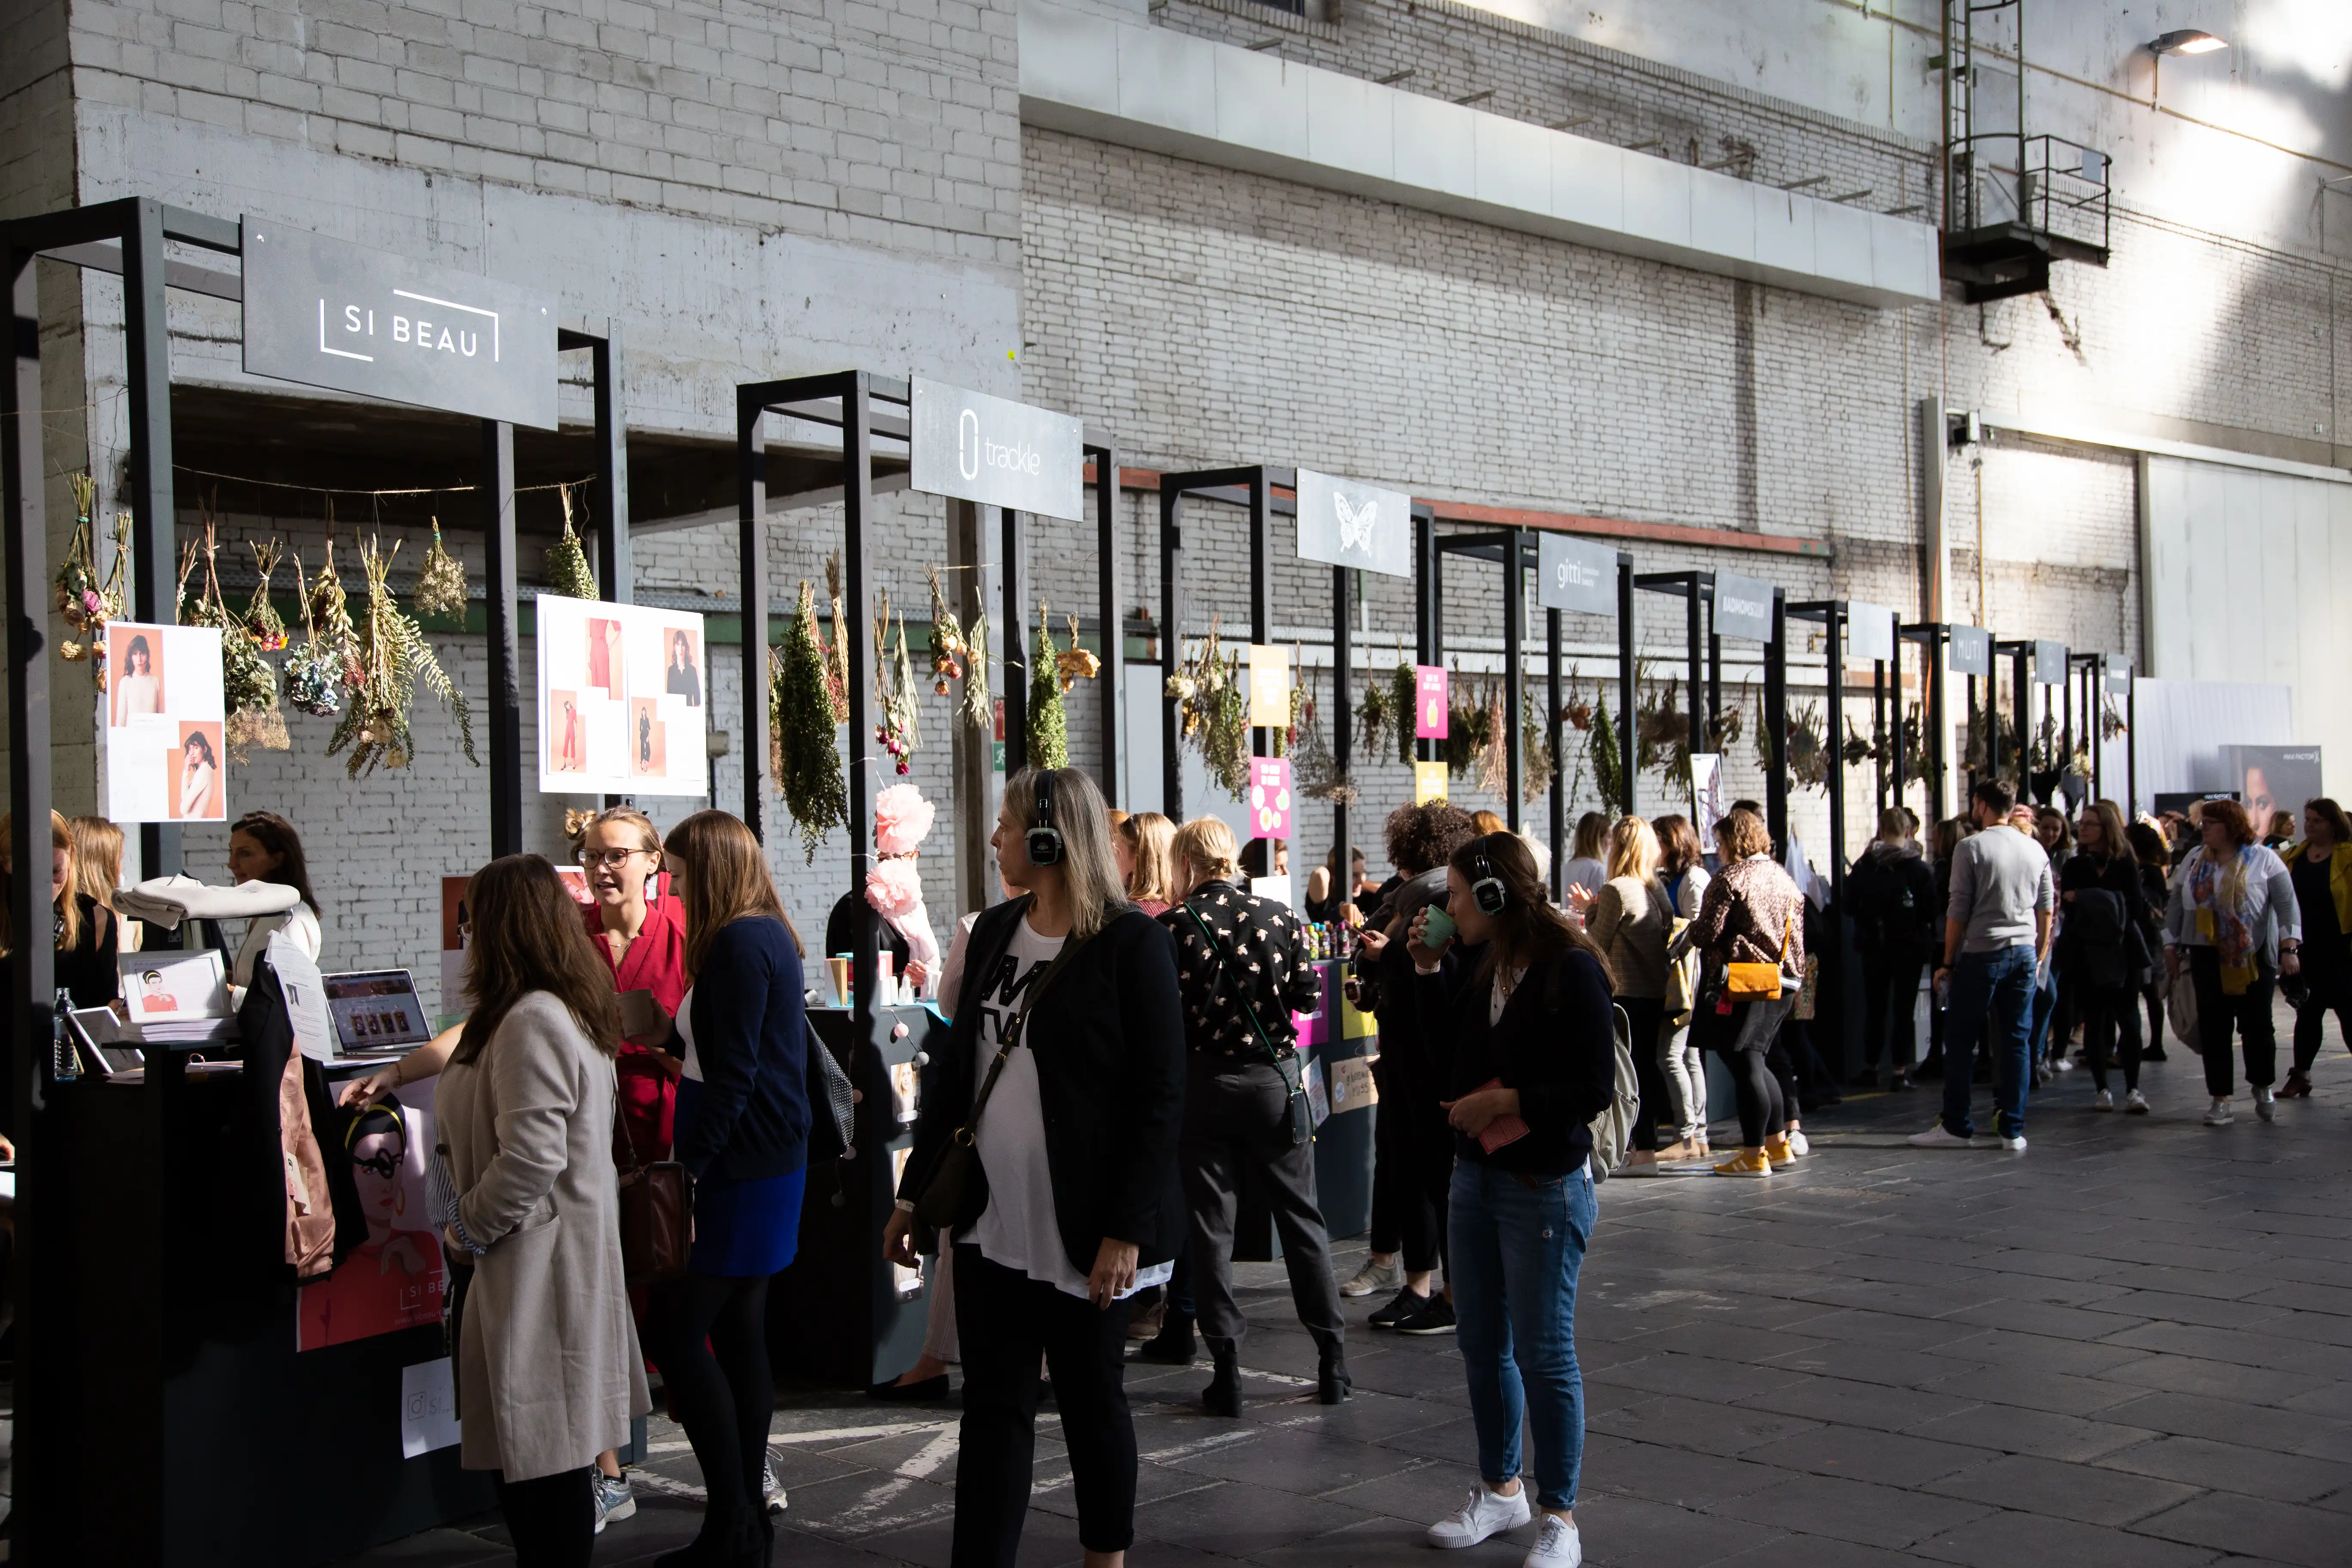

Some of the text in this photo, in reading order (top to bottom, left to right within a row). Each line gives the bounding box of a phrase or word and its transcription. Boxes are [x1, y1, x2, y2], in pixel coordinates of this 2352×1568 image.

[345, 304, 477, 357] SI BEAU
[985, 436, 1041, 476] trackle
[1557, 557, 1581, 589] gitti
[410, 1280, 444, 1297] SI BE
